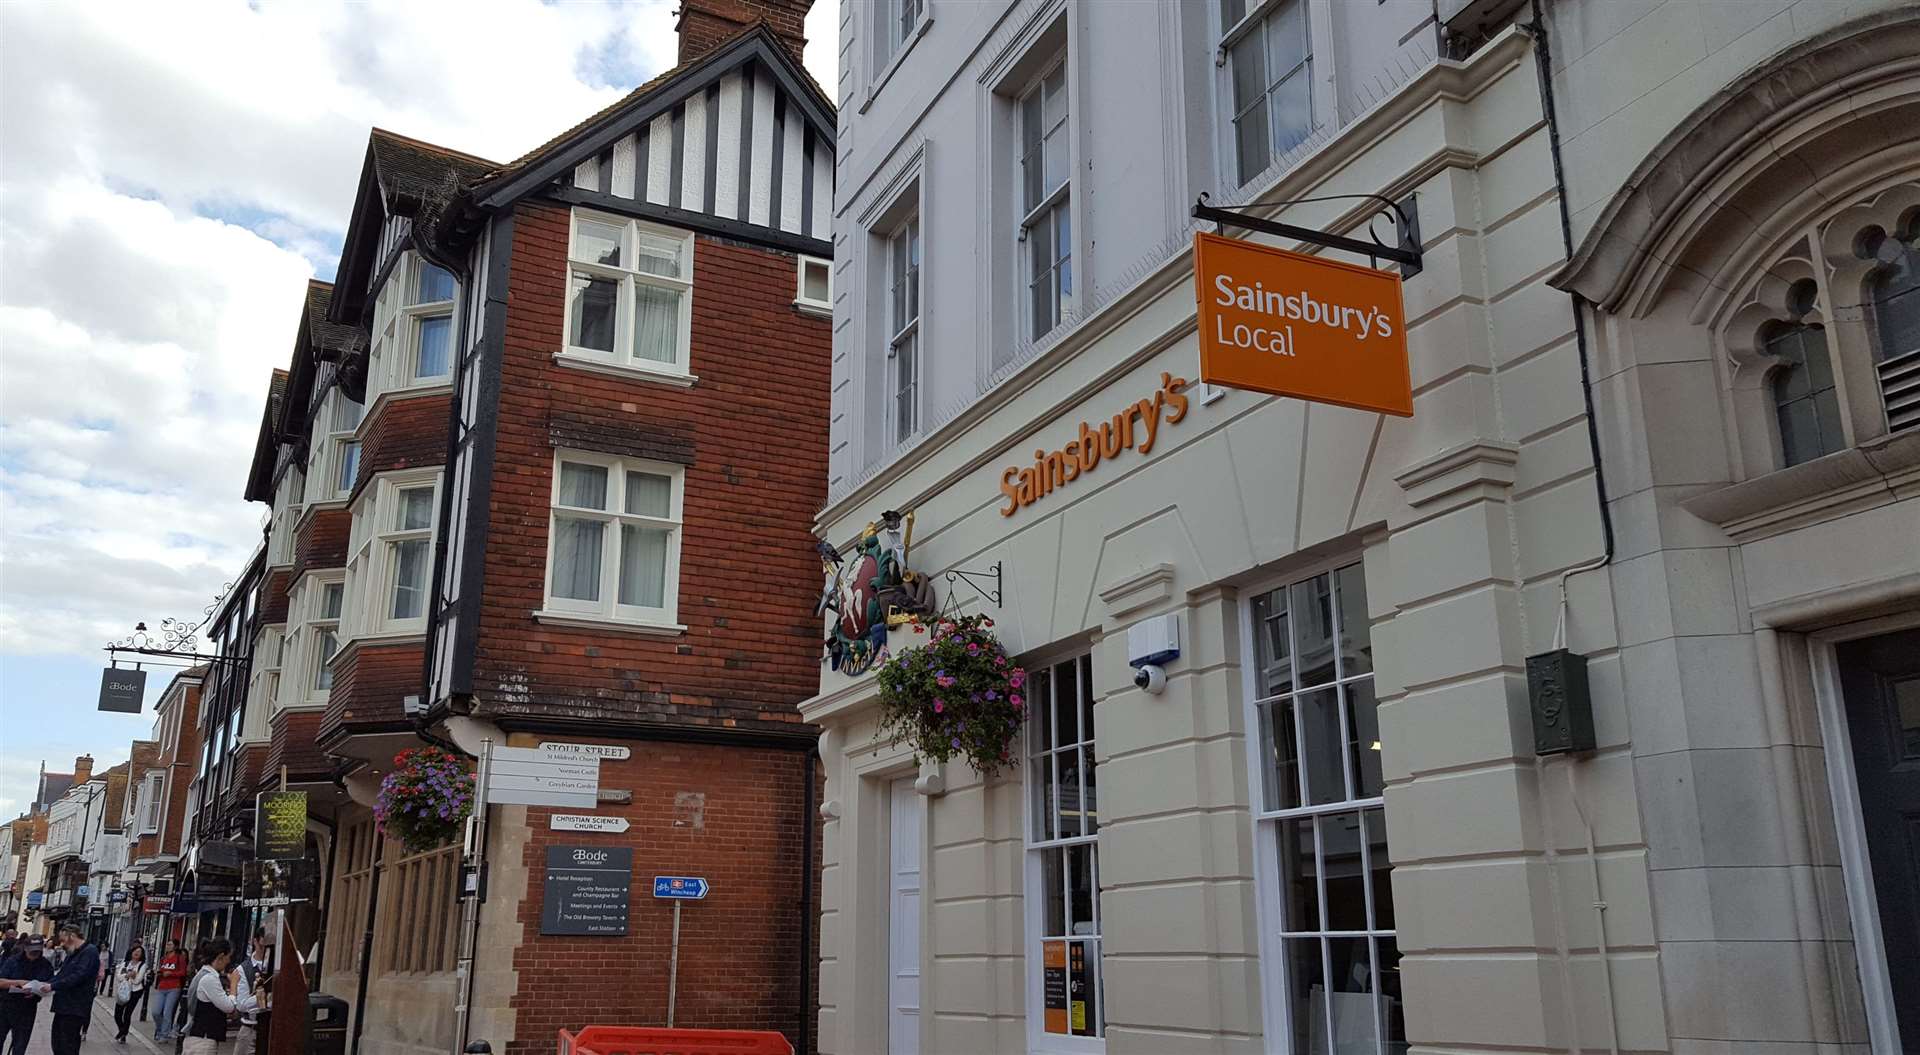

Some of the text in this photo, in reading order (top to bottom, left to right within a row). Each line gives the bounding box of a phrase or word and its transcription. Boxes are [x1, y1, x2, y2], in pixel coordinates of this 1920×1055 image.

[1214, 274, 1392, 341] Sainsbury's
[1216, 314, 1297, 357] Local
[1000, 371, 1189, 517] Sainsbury's
[546, 744, 625, 757] STOUR STREET
[555, 815, 619, 825] CHRISTIAN SCIENCE
